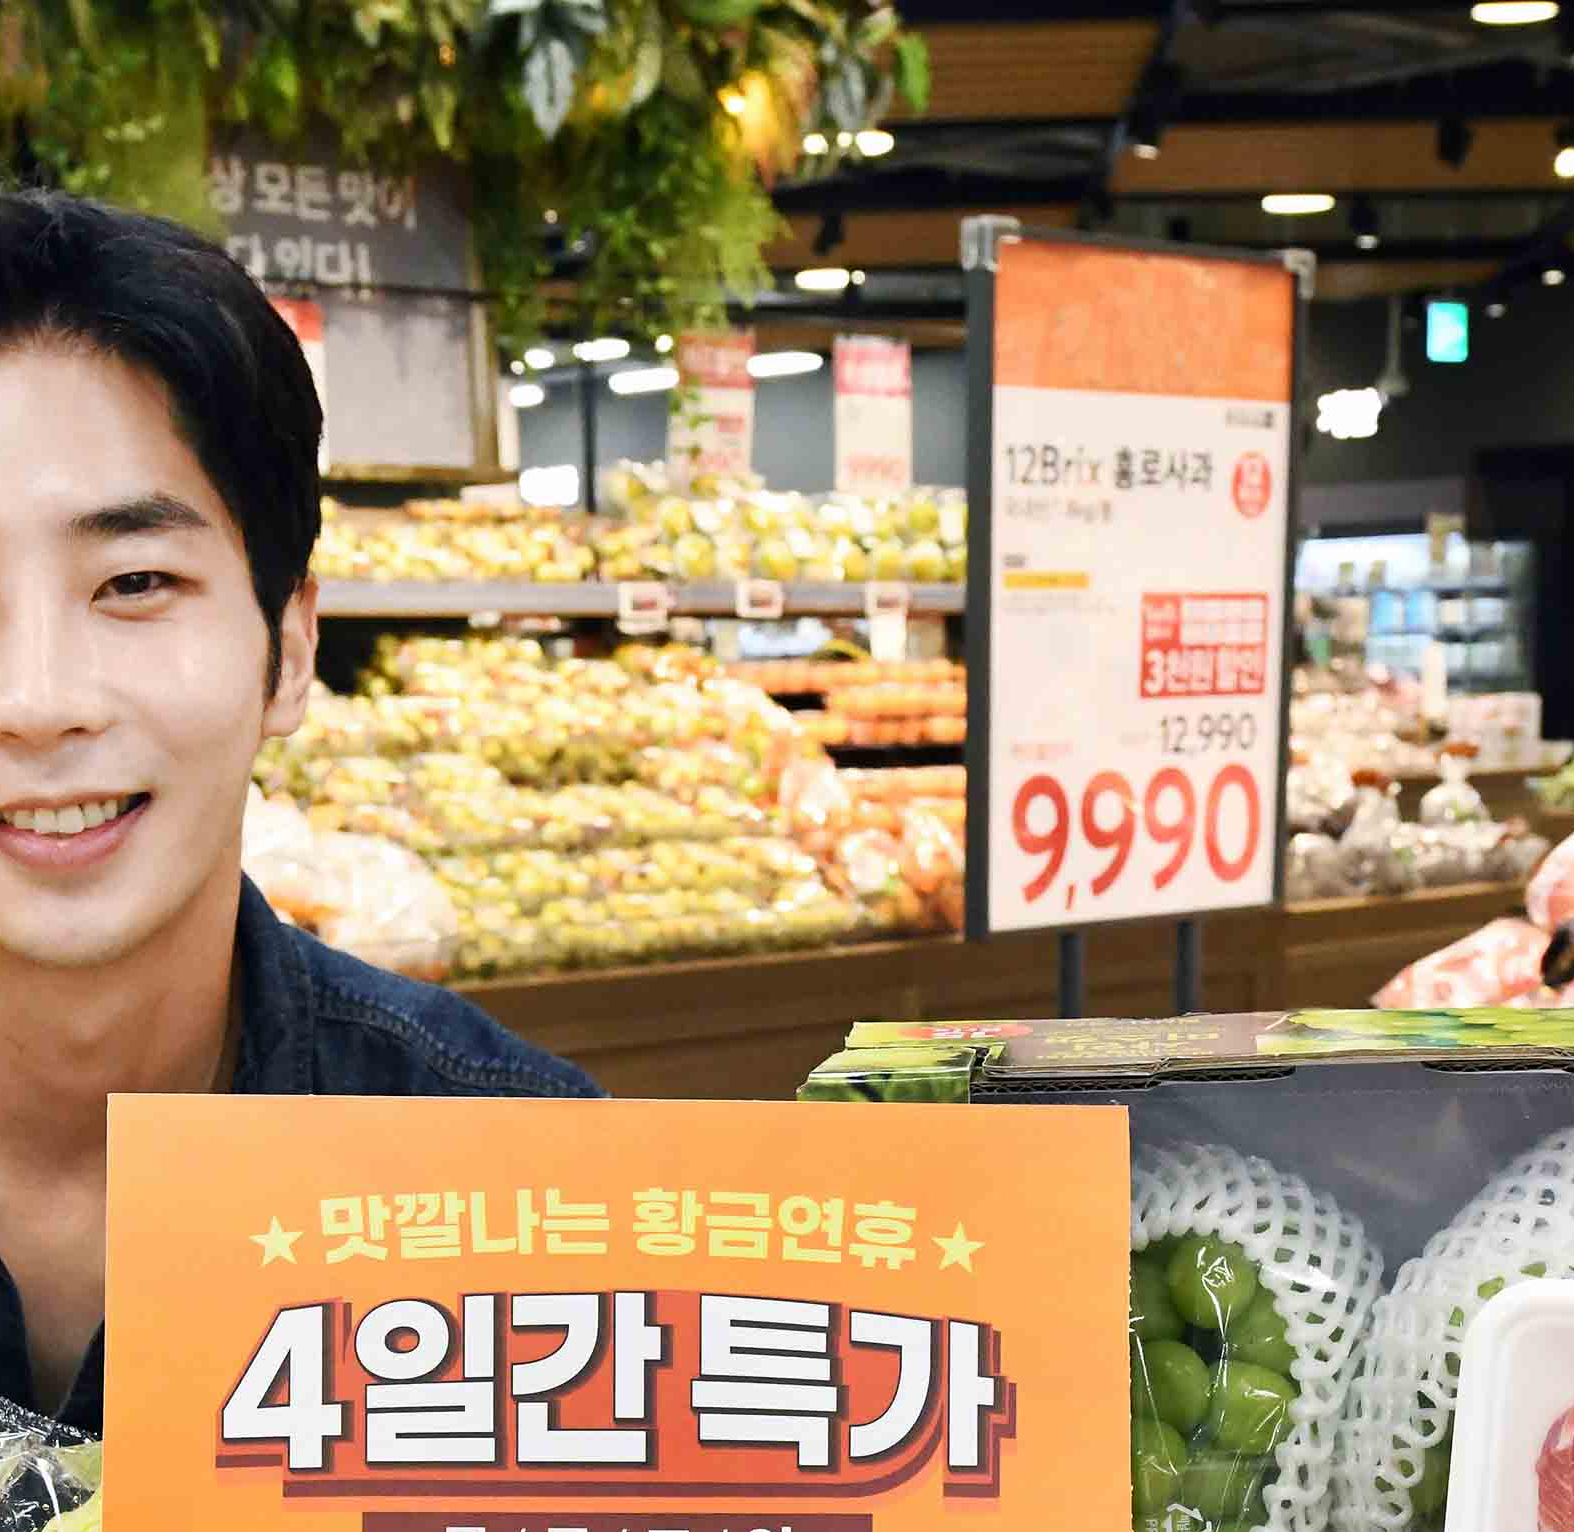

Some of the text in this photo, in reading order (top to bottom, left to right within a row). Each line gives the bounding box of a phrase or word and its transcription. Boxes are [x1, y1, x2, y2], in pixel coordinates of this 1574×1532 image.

[1159, 711, 1258, 755] 12,990
[1011, 762, 1262, 909] 9,990
[318, 1188, 920, 1271] 맛깔나는 황금연휴
[221, 1291, 1000, 1472] 4일간 특가
